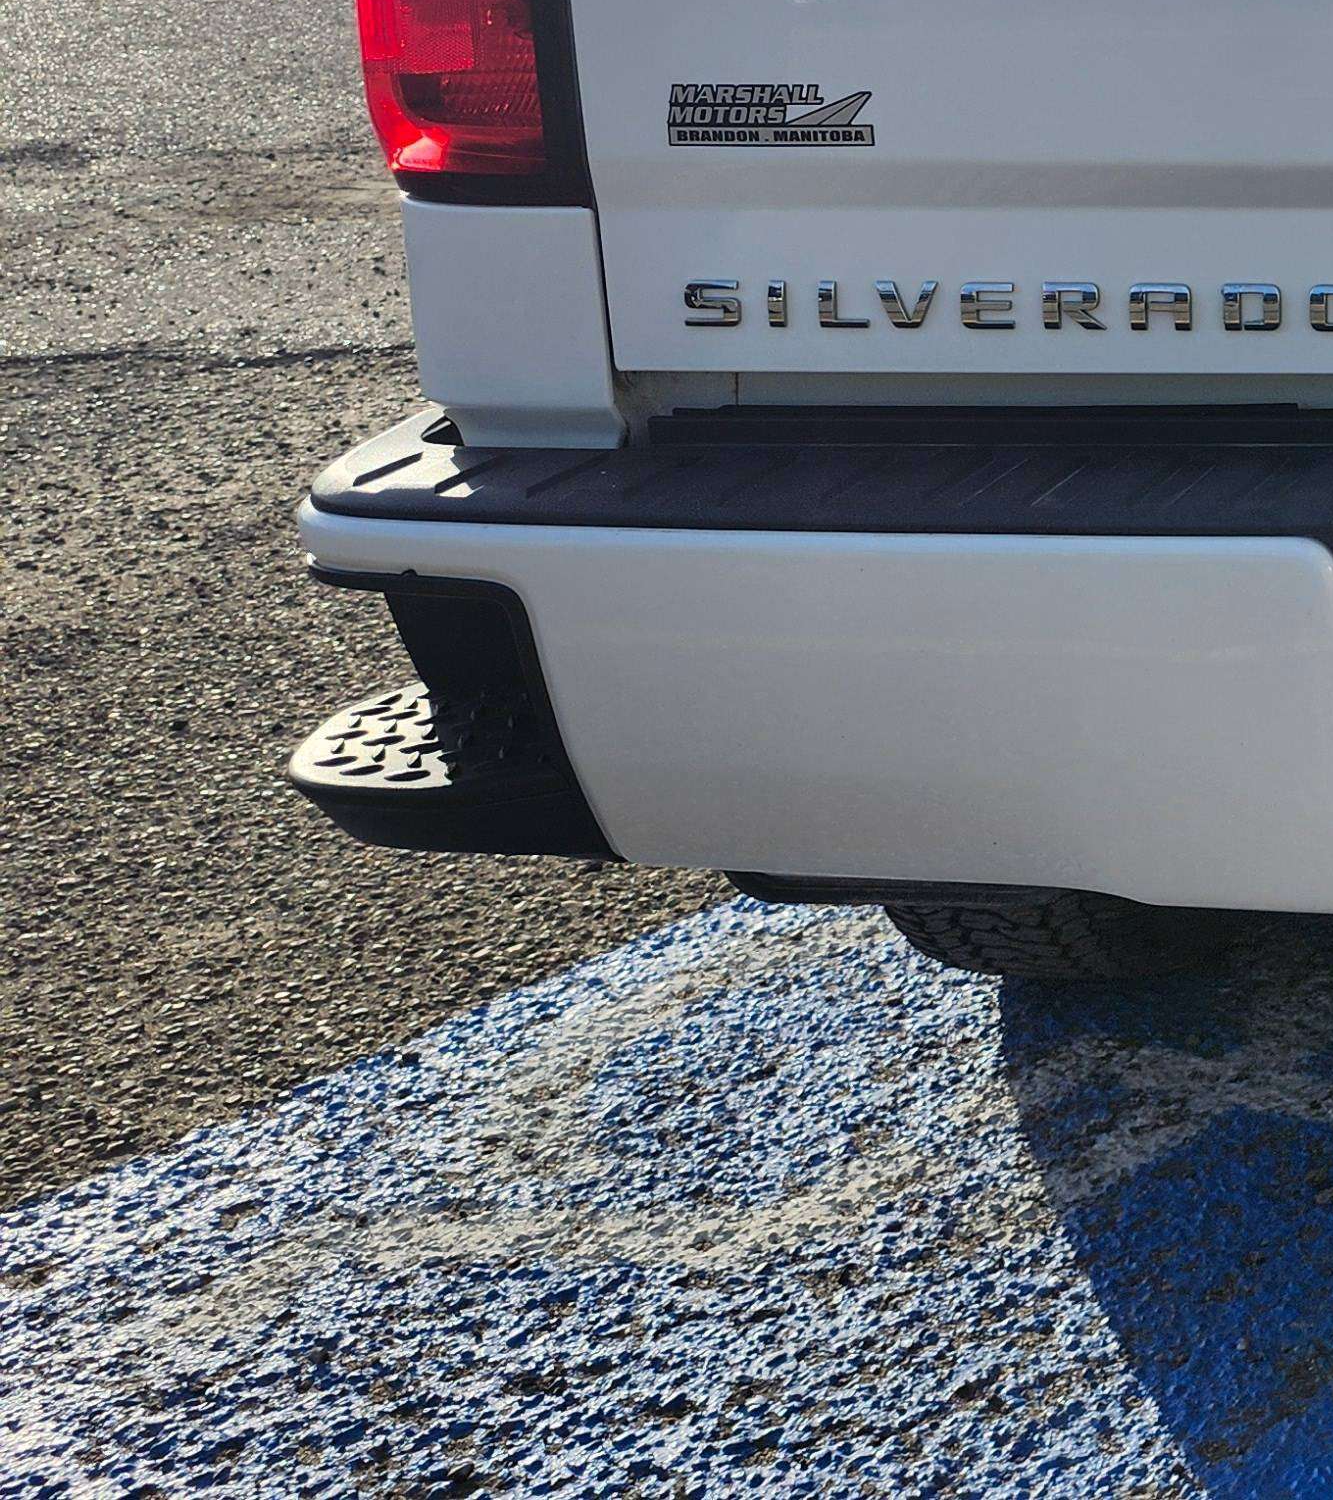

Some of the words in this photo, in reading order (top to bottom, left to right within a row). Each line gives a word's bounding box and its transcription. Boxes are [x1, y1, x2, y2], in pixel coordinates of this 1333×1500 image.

[670, 85, 823, 104] MARSHALL
[669, 105, 785, 124] MOTORS
[676, 130, 760, 142] BRANDON
[773, 130, 866, 142] MANITOBA
